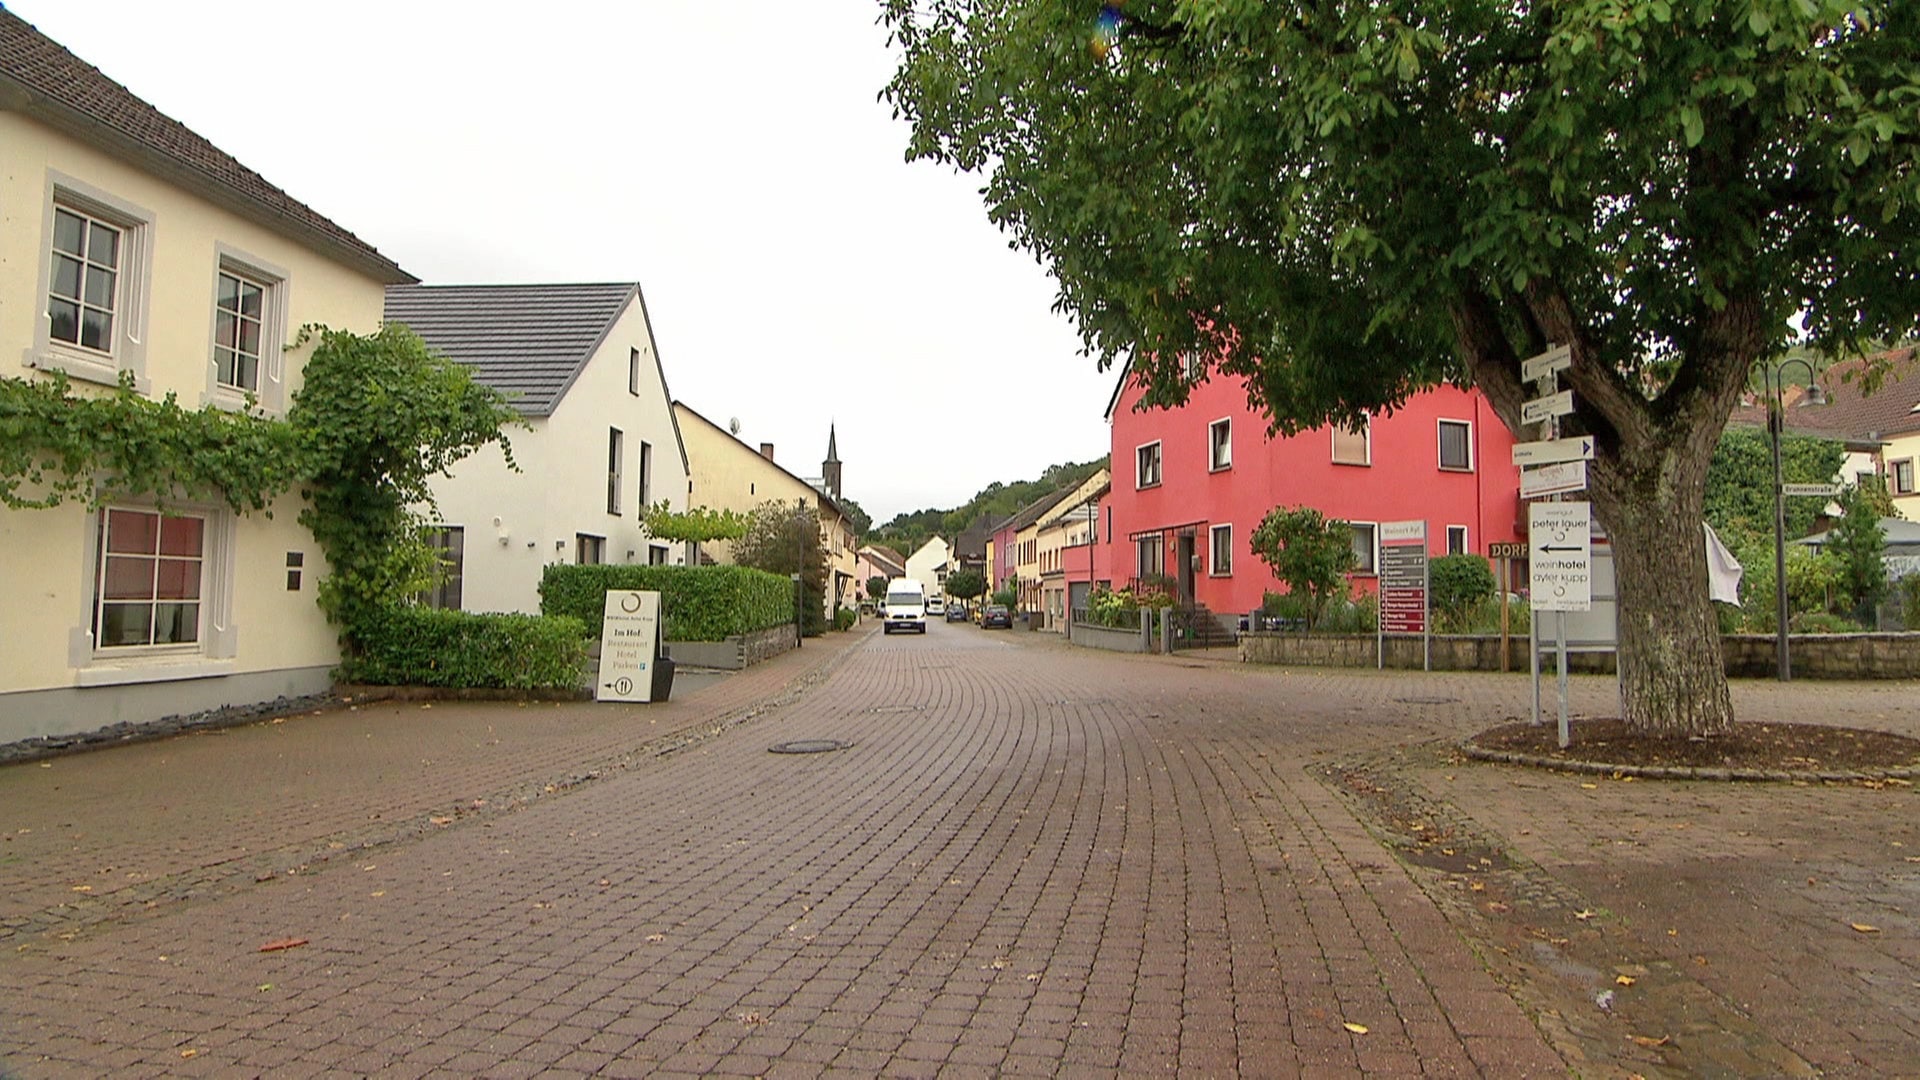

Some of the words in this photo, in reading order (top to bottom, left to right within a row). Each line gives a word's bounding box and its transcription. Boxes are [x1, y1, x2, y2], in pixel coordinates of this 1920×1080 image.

[1532, 519, 1559, 529] peter
[1561, 519, 1588, 528] lauer
[1534, 559, 1587, 569] weinhotel
[1532, 573, 1559, 583] ayler
[1560, 573, 1588, 583] kupp
[614, 628, 625, 637] Im
[607, 639, 648, 649] Restaurant
[616, 650, 637, 659] Hotel
